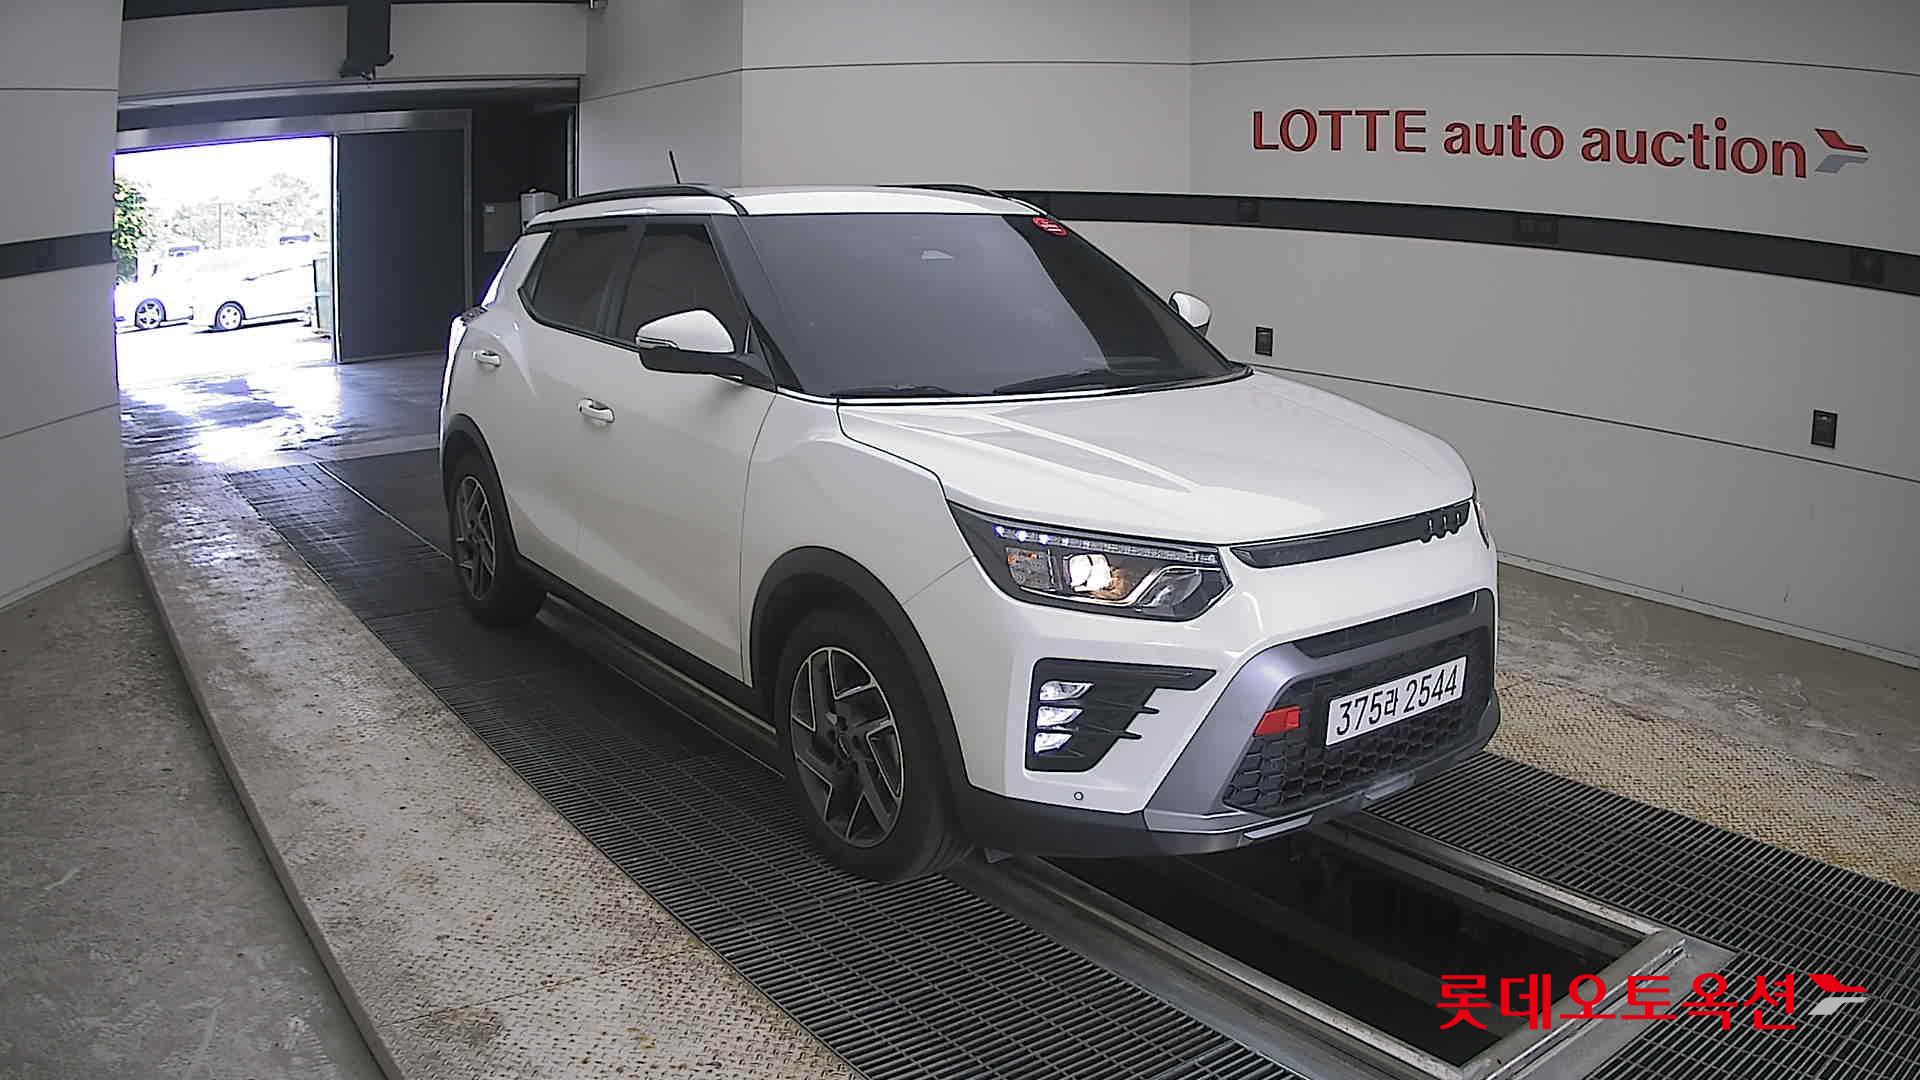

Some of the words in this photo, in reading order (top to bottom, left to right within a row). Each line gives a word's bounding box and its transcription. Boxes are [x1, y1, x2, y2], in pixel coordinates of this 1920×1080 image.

[1252, 109, 1428, 153] LOTTE
[1443, 115, 1566, 161] auto
[1580, 117, 1808, 179] auction
[1336, 688, 1399, 736] 375라
[1403, 664, 1458, 713] 2544
